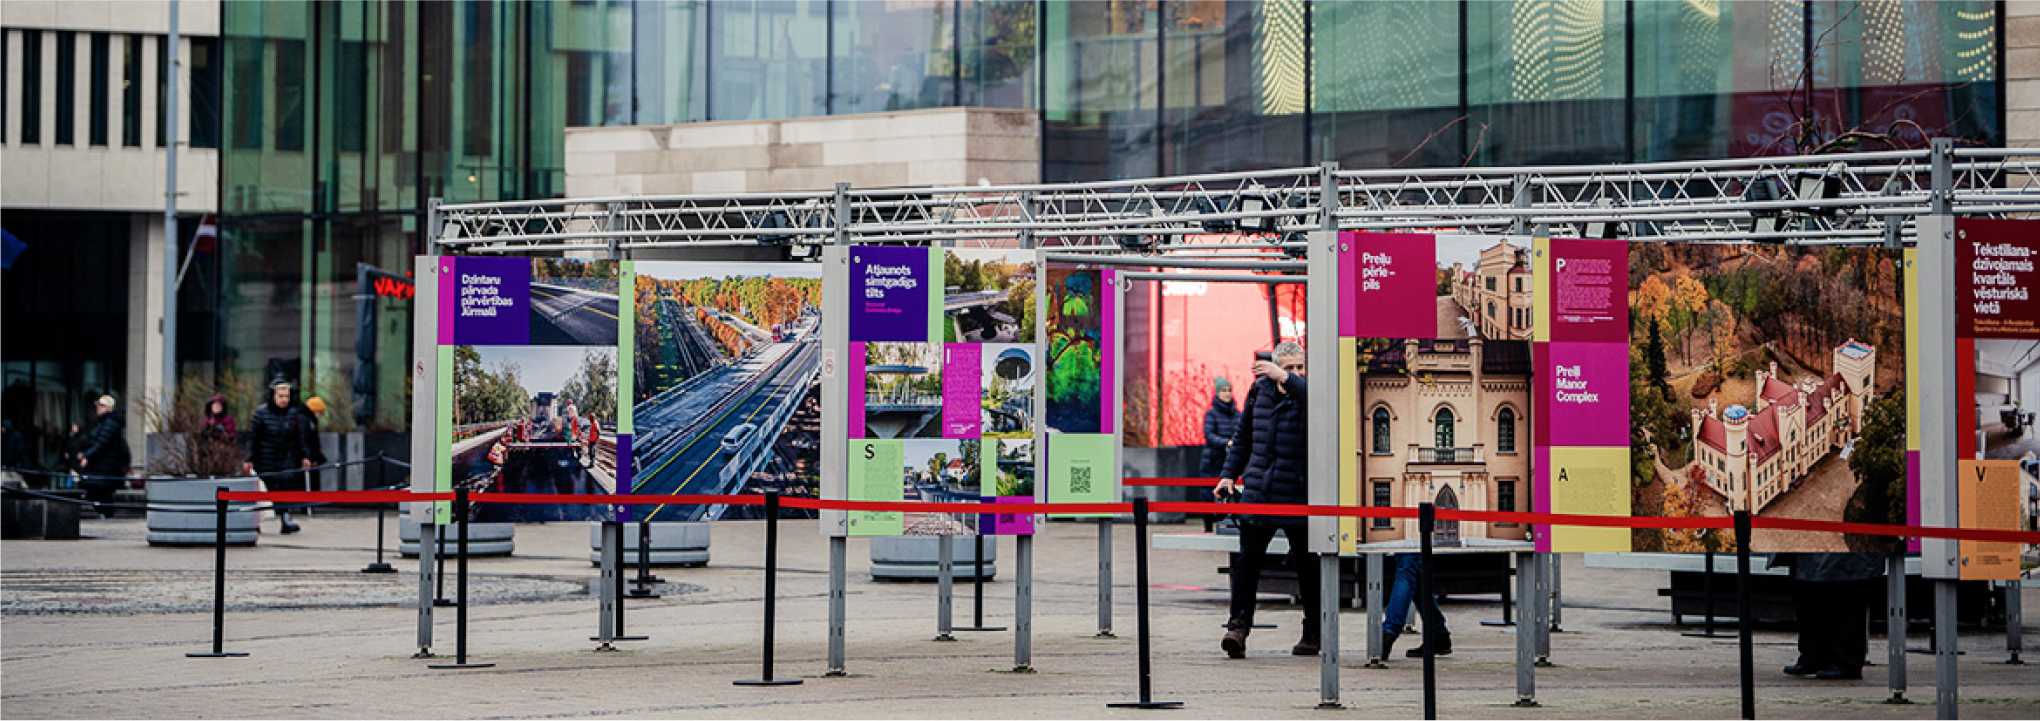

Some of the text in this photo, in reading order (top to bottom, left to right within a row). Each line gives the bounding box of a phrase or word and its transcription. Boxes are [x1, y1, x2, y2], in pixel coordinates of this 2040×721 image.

[1972, 242, 2030, 256] Tekstiliana
[1362, 252, 1392, 267] Preiļu
[1972, 257, 2034, 272] dzīvojamais
[865, 264, 912, 277] Atjaunots
[462, 273, 502, 285] Dzintaru
[1362, 279, 1380, 291] pils
[1973, 271, 2016, 286] kvartāls
[461, 285, 499, 296] pārvada
[865, 287, 884, 299] tilts
[1973, 286, 2028, 300] vēsturiskā
[461, 296, 513, 307] pārvērtības
[1973, 300, 2001, 314] vietā
[461, 306, 497, 317] Jūrmalā
[1556, 378, 1588, 389] Manor
[1556, 390, 1599, 404] Complex
